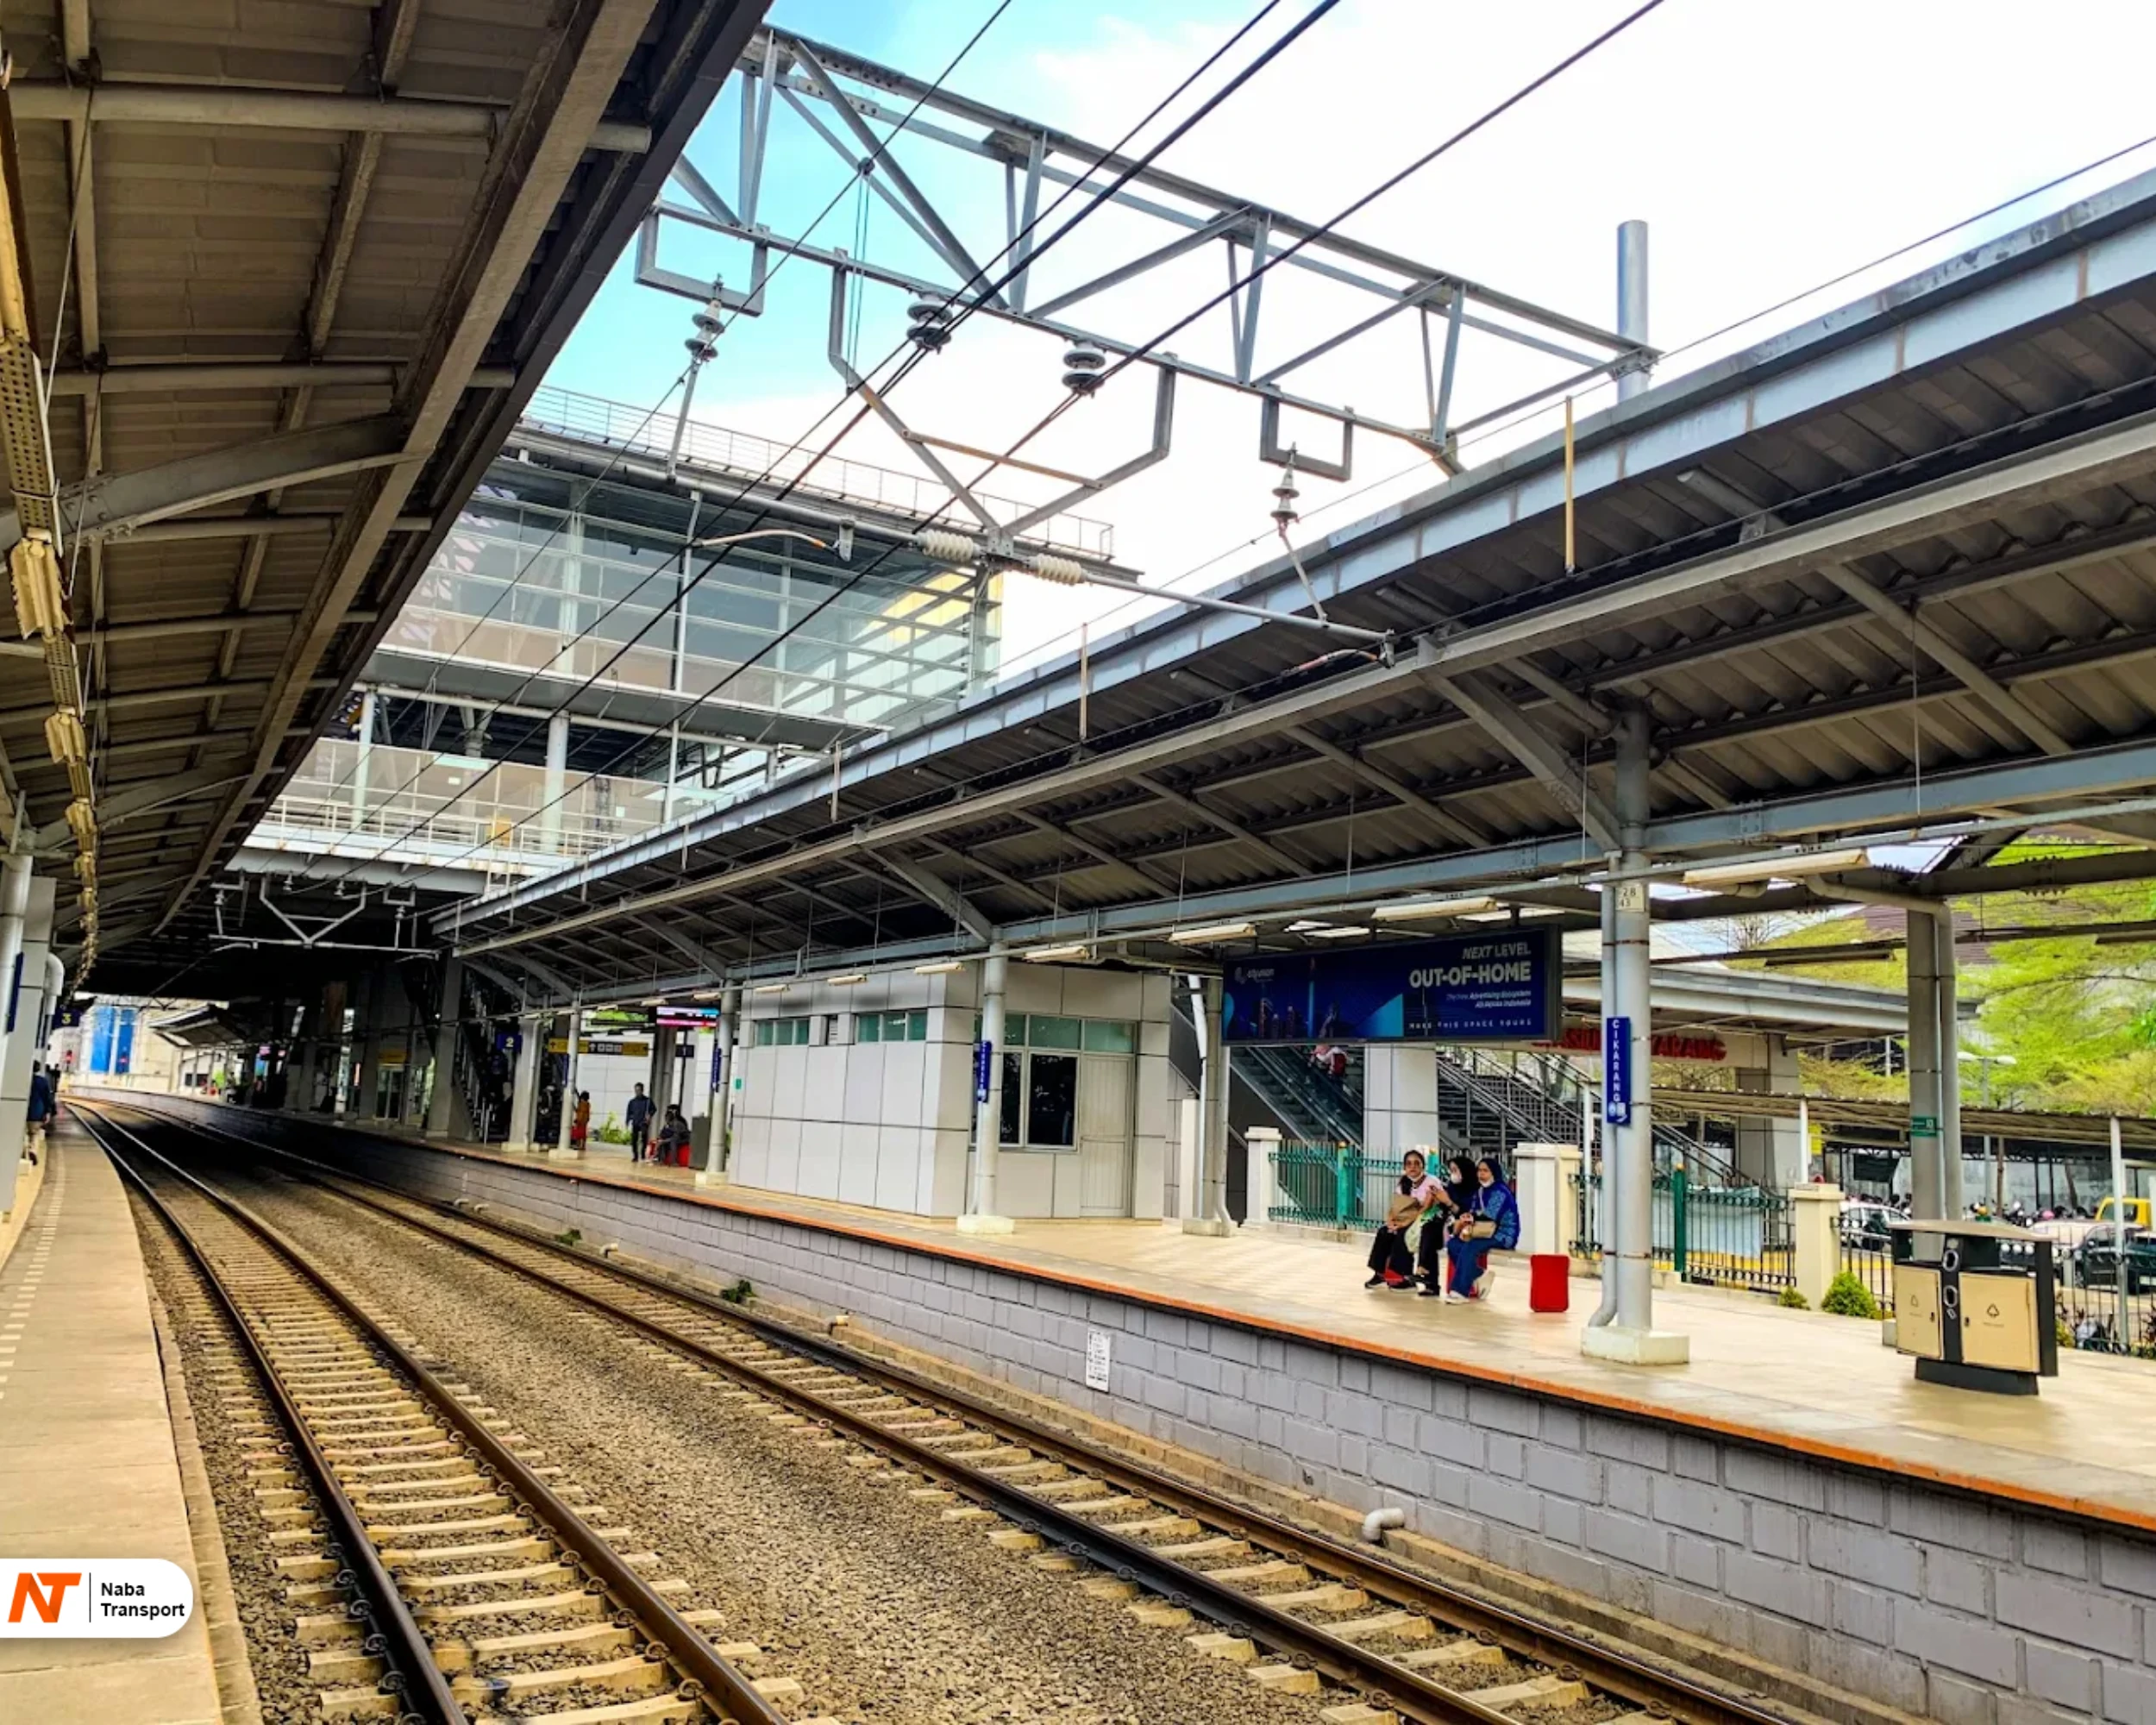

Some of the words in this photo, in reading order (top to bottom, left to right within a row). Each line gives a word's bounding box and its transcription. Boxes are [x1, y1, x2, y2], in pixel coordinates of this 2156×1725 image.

[1463, 945, 1493, 959] NEXT
[1495, 942, 1531, 957] LEVEL
[1409, 961, 1532, 988] OUT-OF-HOME
[62, 1013, 72, 1025] 3
[505, 1037, 514, 1048] 2
[1612, 1019, 1620, 1101] CIKARANG
